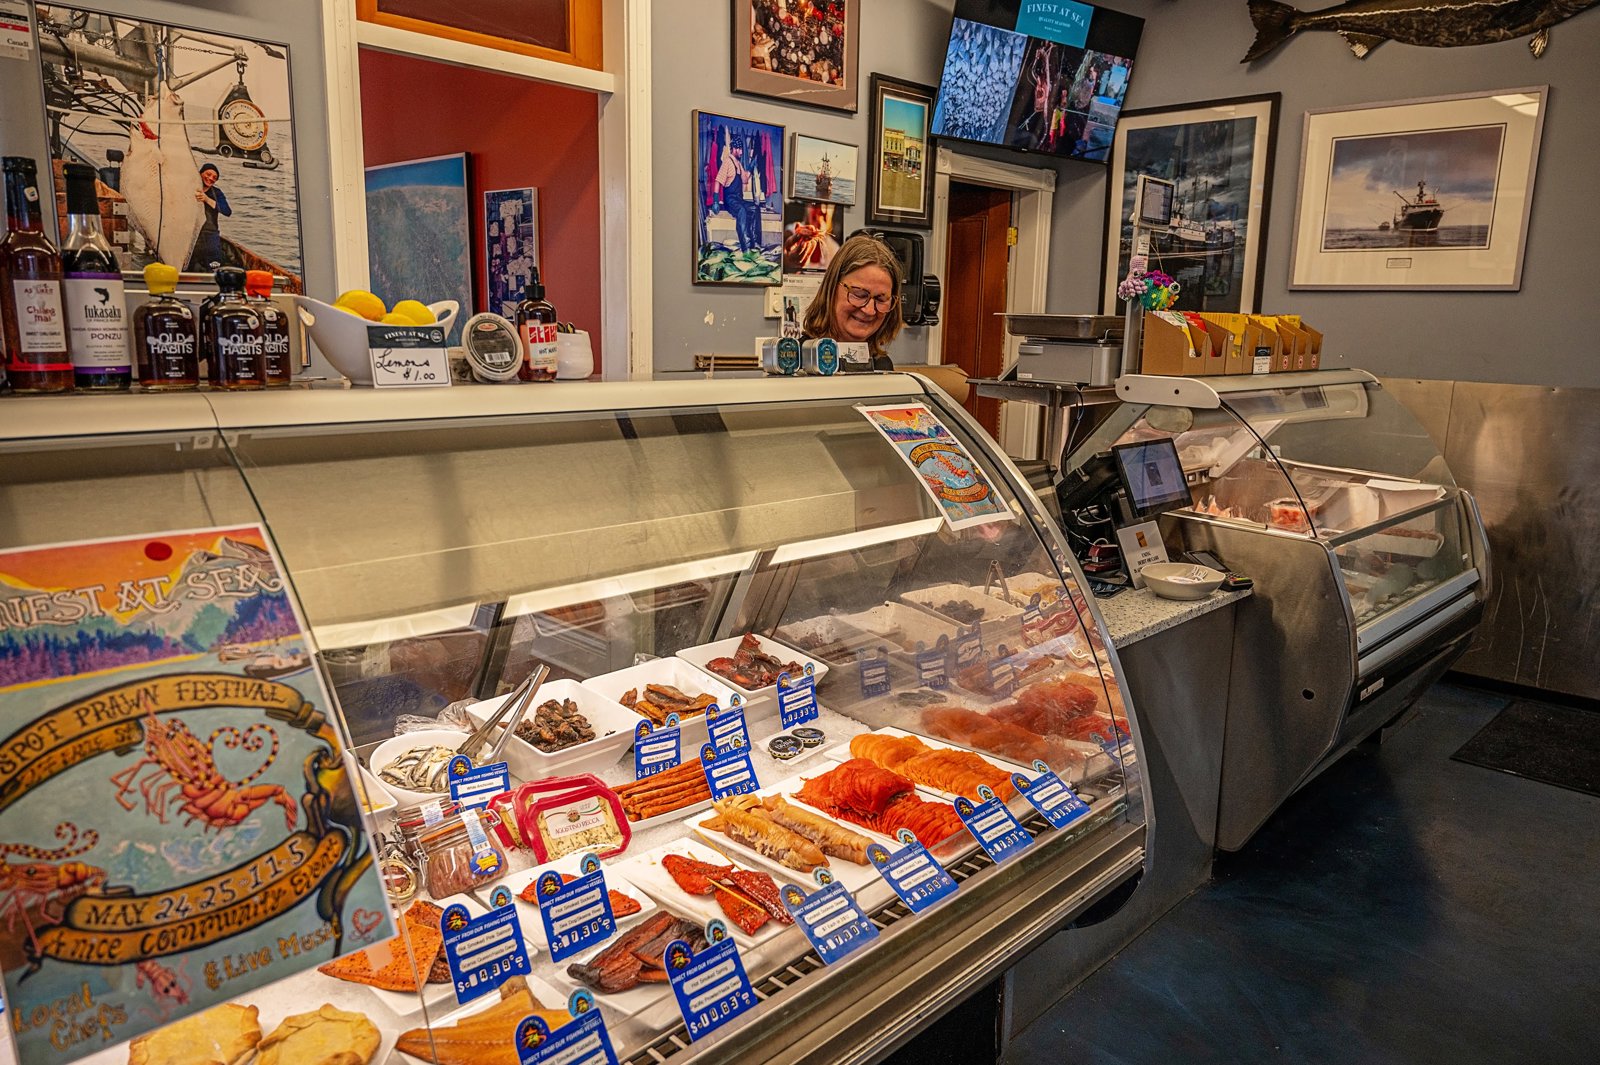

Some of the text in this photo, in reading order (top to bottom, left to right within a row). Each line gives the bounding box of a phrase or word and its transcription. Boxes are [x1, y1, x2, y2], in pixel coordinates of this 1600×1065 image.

[1027, 3, 1086, 28] FINEST AT SEA
[159, 333, 185, 344] OLD
[230, 334, 255, 345] OLD
[384, 331, 406, 339] FINEST
[417, 331, 430, 340] SEA
[151, 343, 194, 354] HABITS
[222, 344, 262, 355] HABITS
[376, 348, 430, 373] Lemons
[116, 576, 182, 614] AT
[187, 563, 286, 602] SEA
[0, 678, 289, 776] SPOT PRAWN FESTIVAL
[555, 817, 600, 834] AGOSTINO RECCA
[84, 903, 149, 927] MAY
[154, 894, 192, 923] 24
[200, 879, 236, 912] 25
[540, 878, 604, 909] DIRECT FROM OUR FISHING VESSELS
[563, 901, 580, 909] Smoked
[445, 912, 517, 945] DIRECT FROM OUR FISHING VESSELS
[70, 935, 122, 963] nice
[225, 943, 274, 981] Live
[278, 921, 342, 961] Music
[467, 938, 485, 949] Smoked
[672, 946, 736, 985] DIRECT FROM OUR FISHING VESSELS
[700, 973, 715, 984] Smoked
